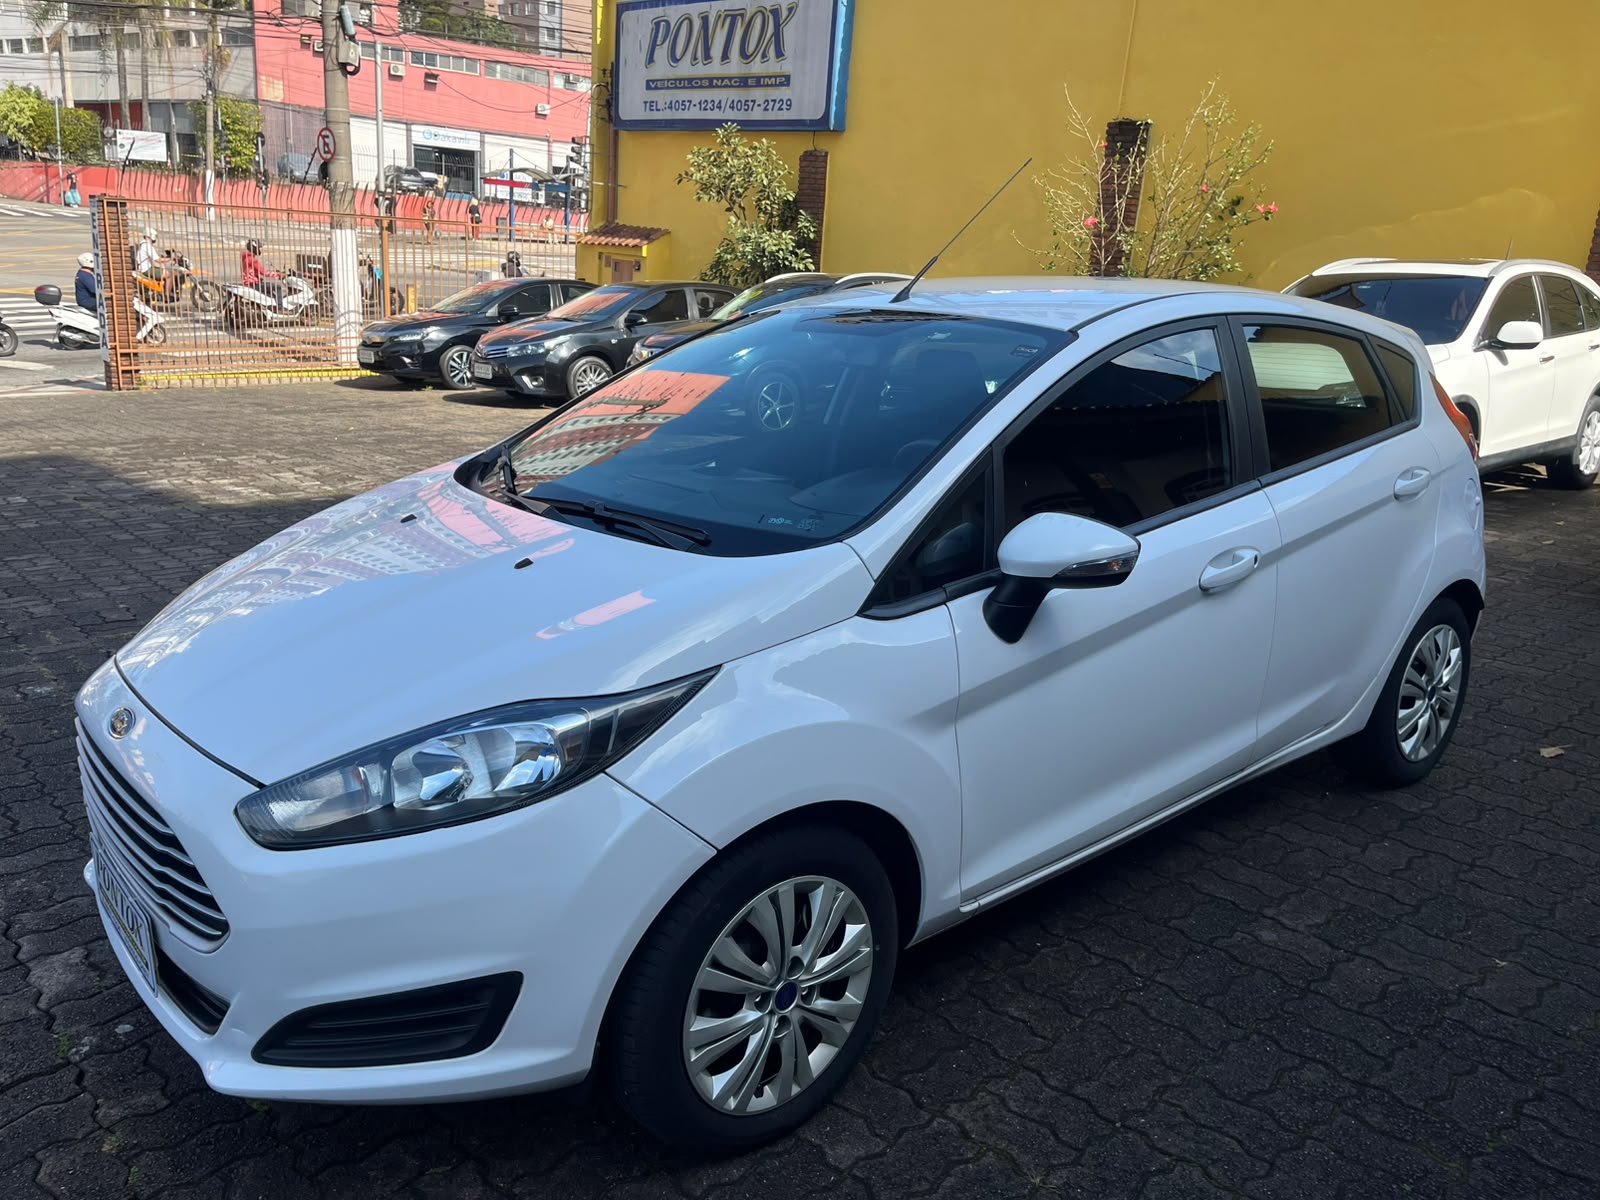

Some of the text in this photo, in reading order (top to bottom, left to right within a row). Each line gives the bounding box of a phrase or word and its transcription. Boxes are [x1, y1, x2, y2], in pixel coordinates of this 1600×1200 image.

[645, 1, 798, 69] PONTOX
[712, 78, 743, 87] NAC.
[748, 78, 758, 86] E
[91, 212, 108, 349] ENTRADA
